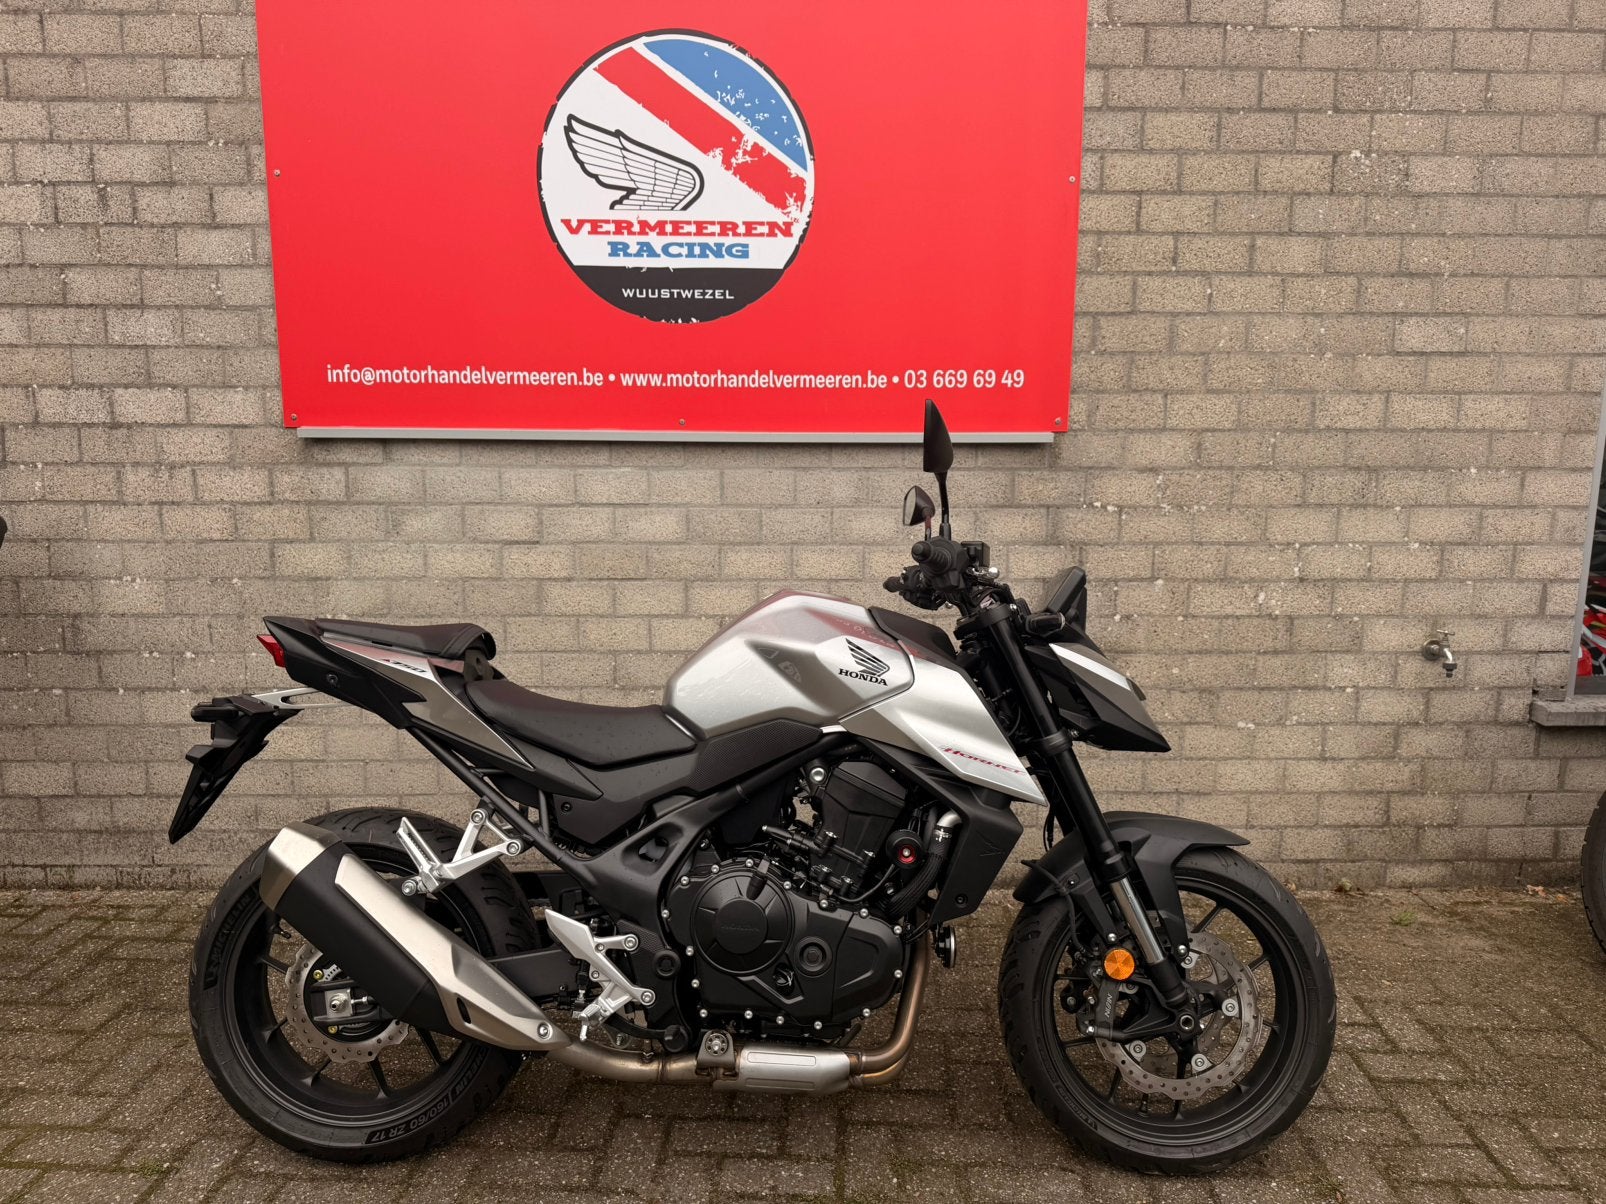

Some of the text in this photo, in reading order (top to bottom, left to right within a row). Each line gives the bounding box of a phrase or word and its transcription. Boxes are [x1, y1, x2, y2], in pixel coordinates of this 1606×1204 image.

[560, 219, 794, 237] VERMEEREN
[607, 241, 750, 259] RACING
[622, 288, 735, 299] WUUSTWEZEL
[326, 364, 1025, 388] info@motorhandelvermeeren.be www.motorhandelvermeeren.be 03 669 69 49
[838, 668, 889, 687] HONDA
[370, 1129, 387, 1142] 17
[388, 1121, 407, 1138] ZR
